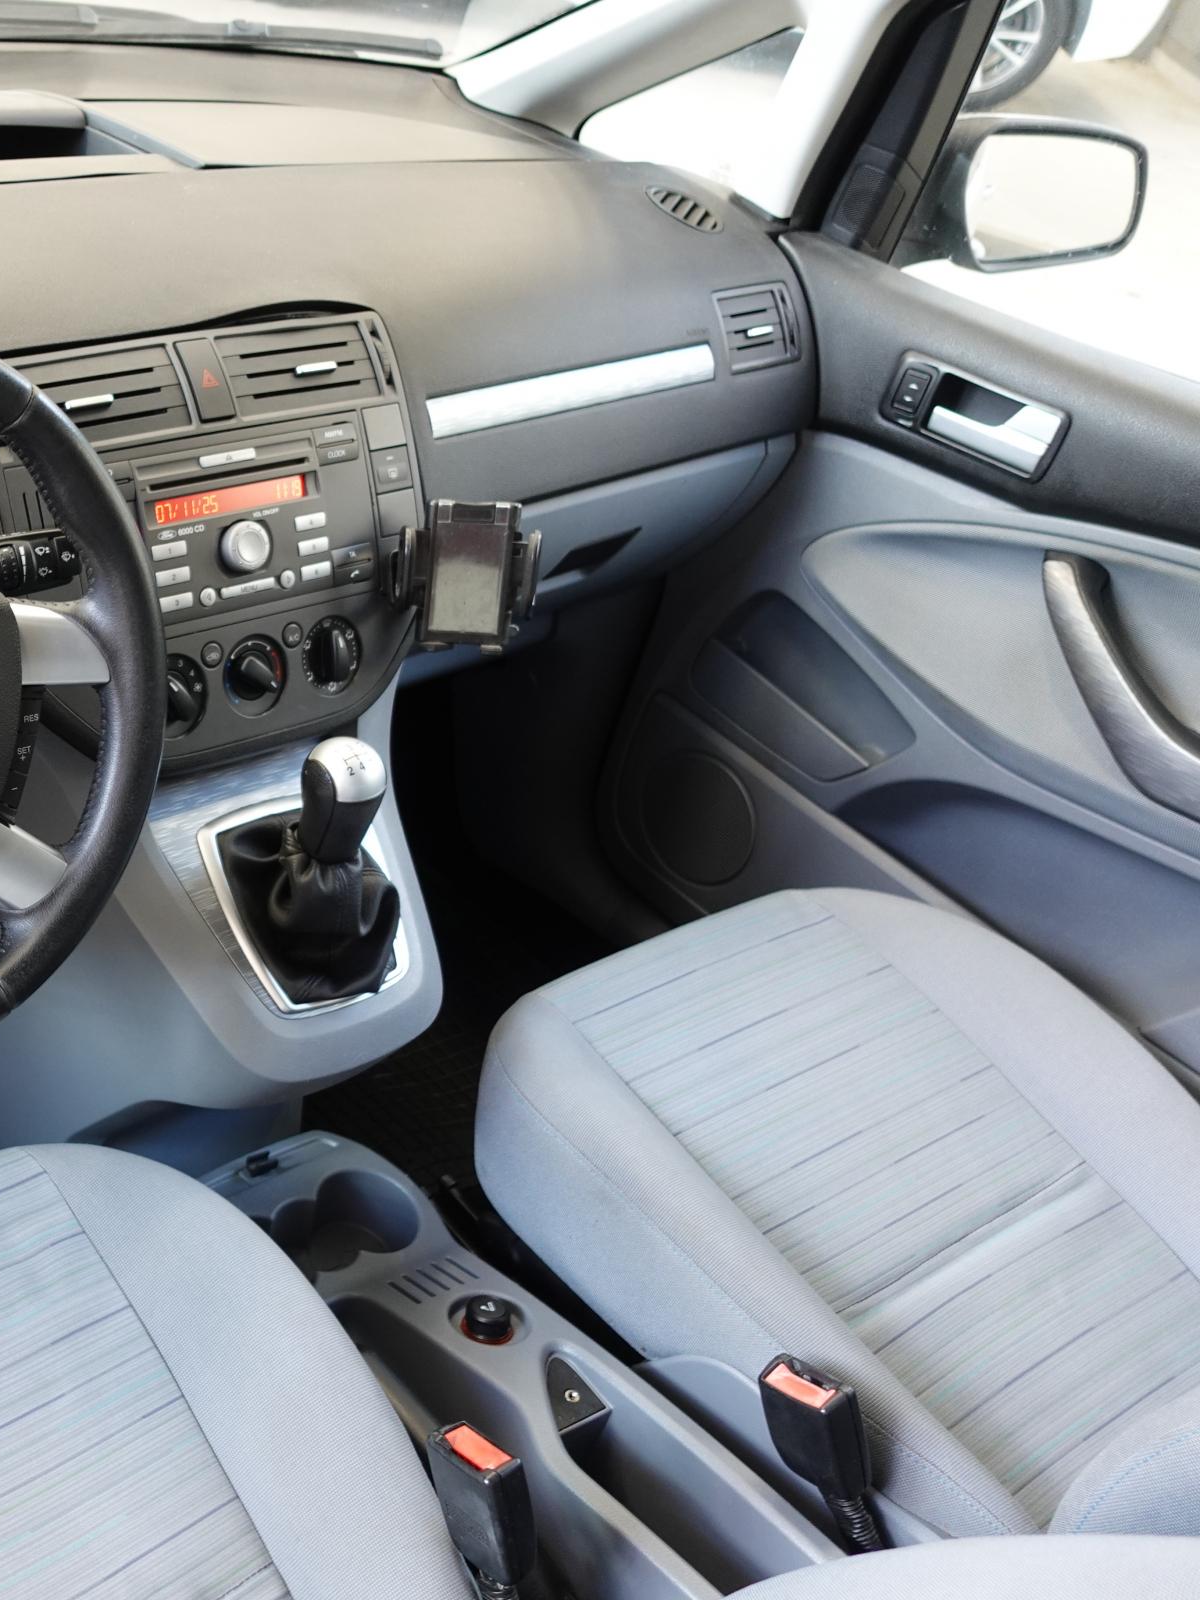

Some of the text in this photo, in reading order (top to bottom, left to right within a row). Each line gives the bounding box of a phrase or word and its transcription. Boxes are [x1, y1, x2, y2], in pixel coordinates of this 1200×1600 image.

[327, 449, 346, 459] CLOCK
[155, 494, 219, 524] 07/11/25
[194, 524, 205, 533] CD
[177, 659, 184, 668] 3
[188, 668, 195, 677] 4
[23, 713, 40, 724] RES
[17, 745, 32, 755] SET
[346, 761, 366, 777] 2 4
